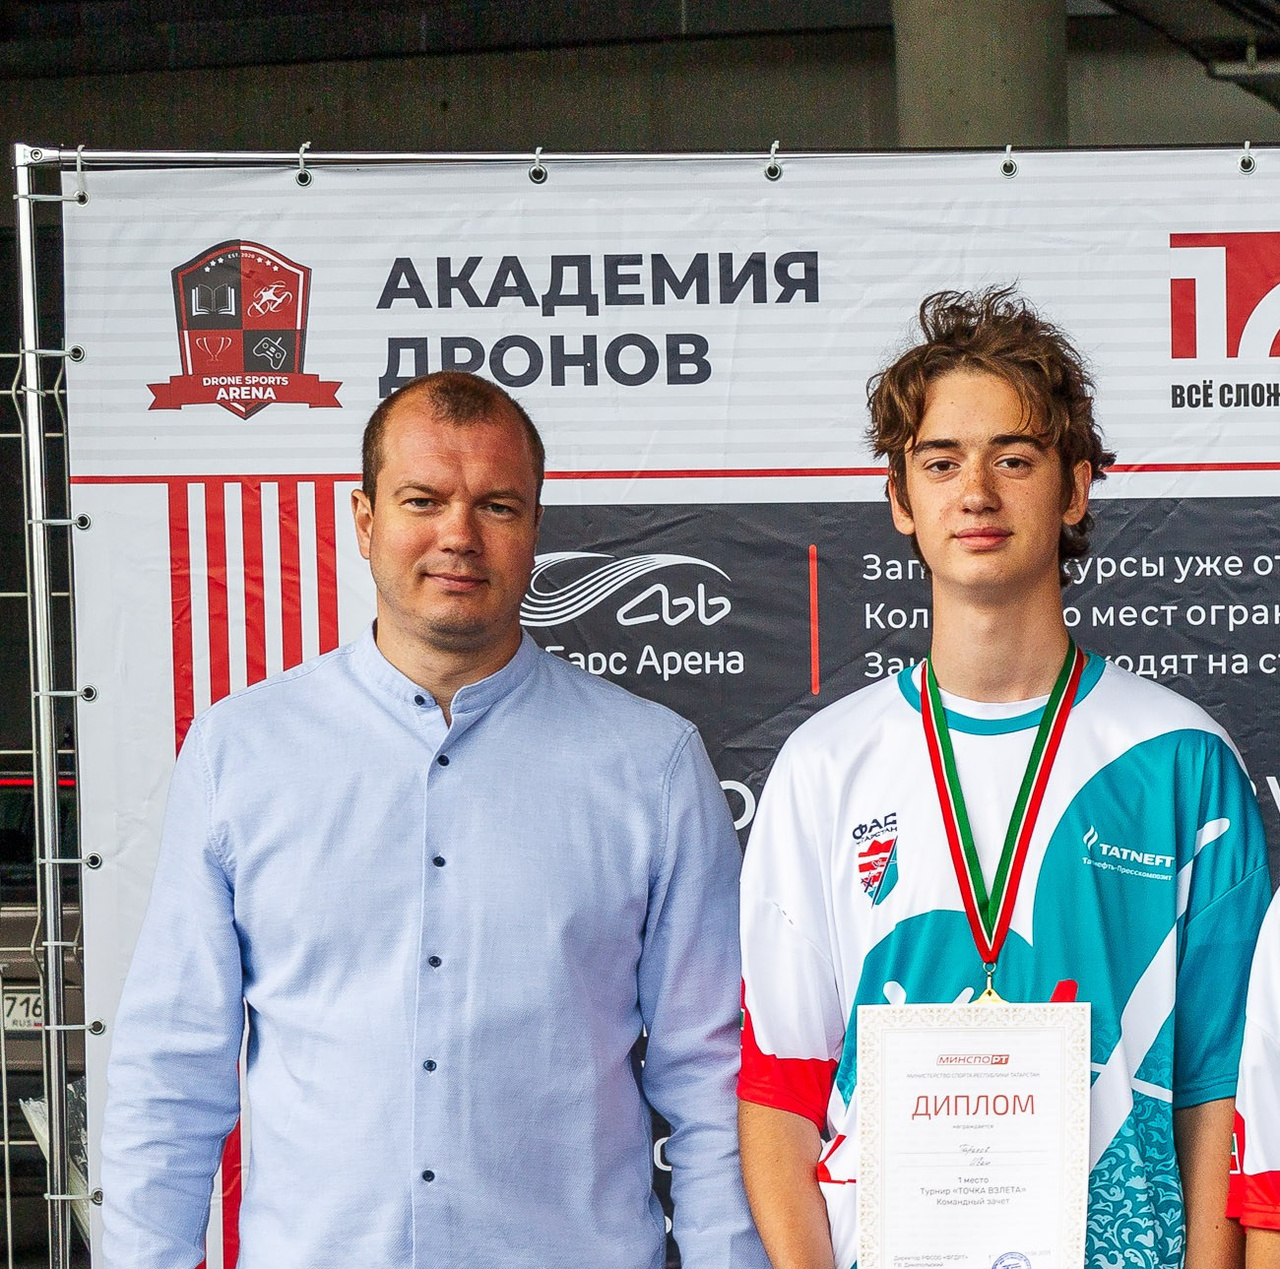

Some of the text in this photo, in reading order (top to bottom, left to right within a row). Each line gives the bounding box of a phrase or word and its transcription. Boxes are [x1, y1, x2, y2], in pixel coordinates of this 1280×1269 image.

[377, 250, 819, 316] АКАДЕМИЯ
[378, 333, 713, 399] ДРОНОВ
[202, 375, 289, 387] DRONE SPORTS
[216, 386, 277, 401] ARENA
[1170, 380, 1214, 409] ВСЁ
[862, 553, 925, 581] Зап
[1064, 555, 1164, 585] урсы
[1174, 555, 1243, 585] уже
[1092, 605, 1177, 627] мест
[545, 644, 745, 682] арс Арена
[1209, 654, 1248, 675] на
[852, 812, 897, 840] ФАС
[1099, 843, 1176, 868] TATNEFT
[938, 1055, 1009, 1065] МИНСПОРТ
[912, 1094, 1034, 1120] ДИПЛОМ
[920, 1186, 1026, 1196] Турнир «ТОЧКА ВЗЛЕТА»
[936, 1198, 985, 1206] Командный
